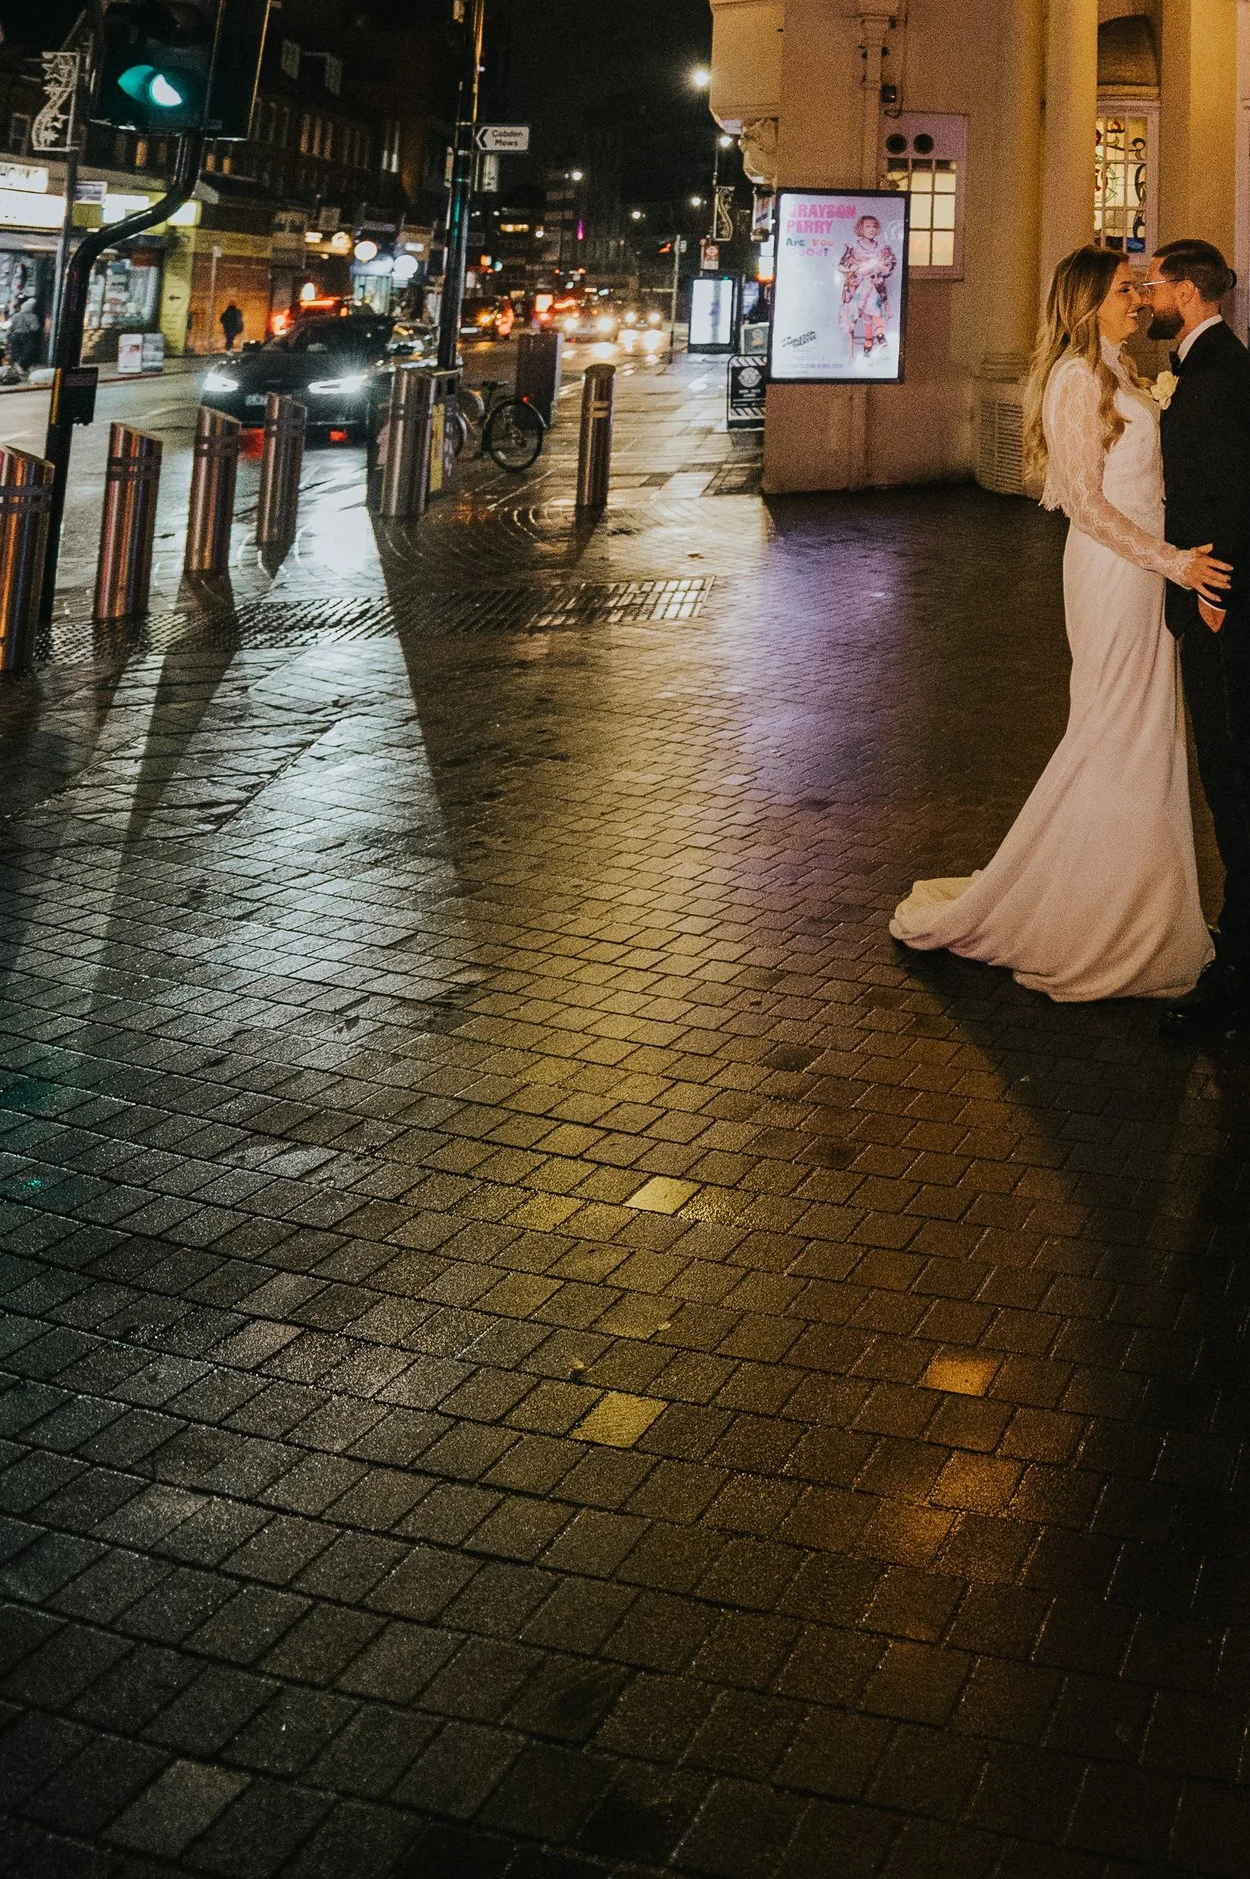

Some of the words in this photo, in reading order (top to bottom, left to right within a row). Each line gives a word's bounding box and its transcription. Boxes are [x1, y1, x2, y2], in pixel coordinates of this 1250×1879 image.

[492, 130, 523, 138] Cobden
[495, 139, 518, 147] Mews
[787, 219, 833, 234] PERRY
[786, 238, 806, 247] Are
